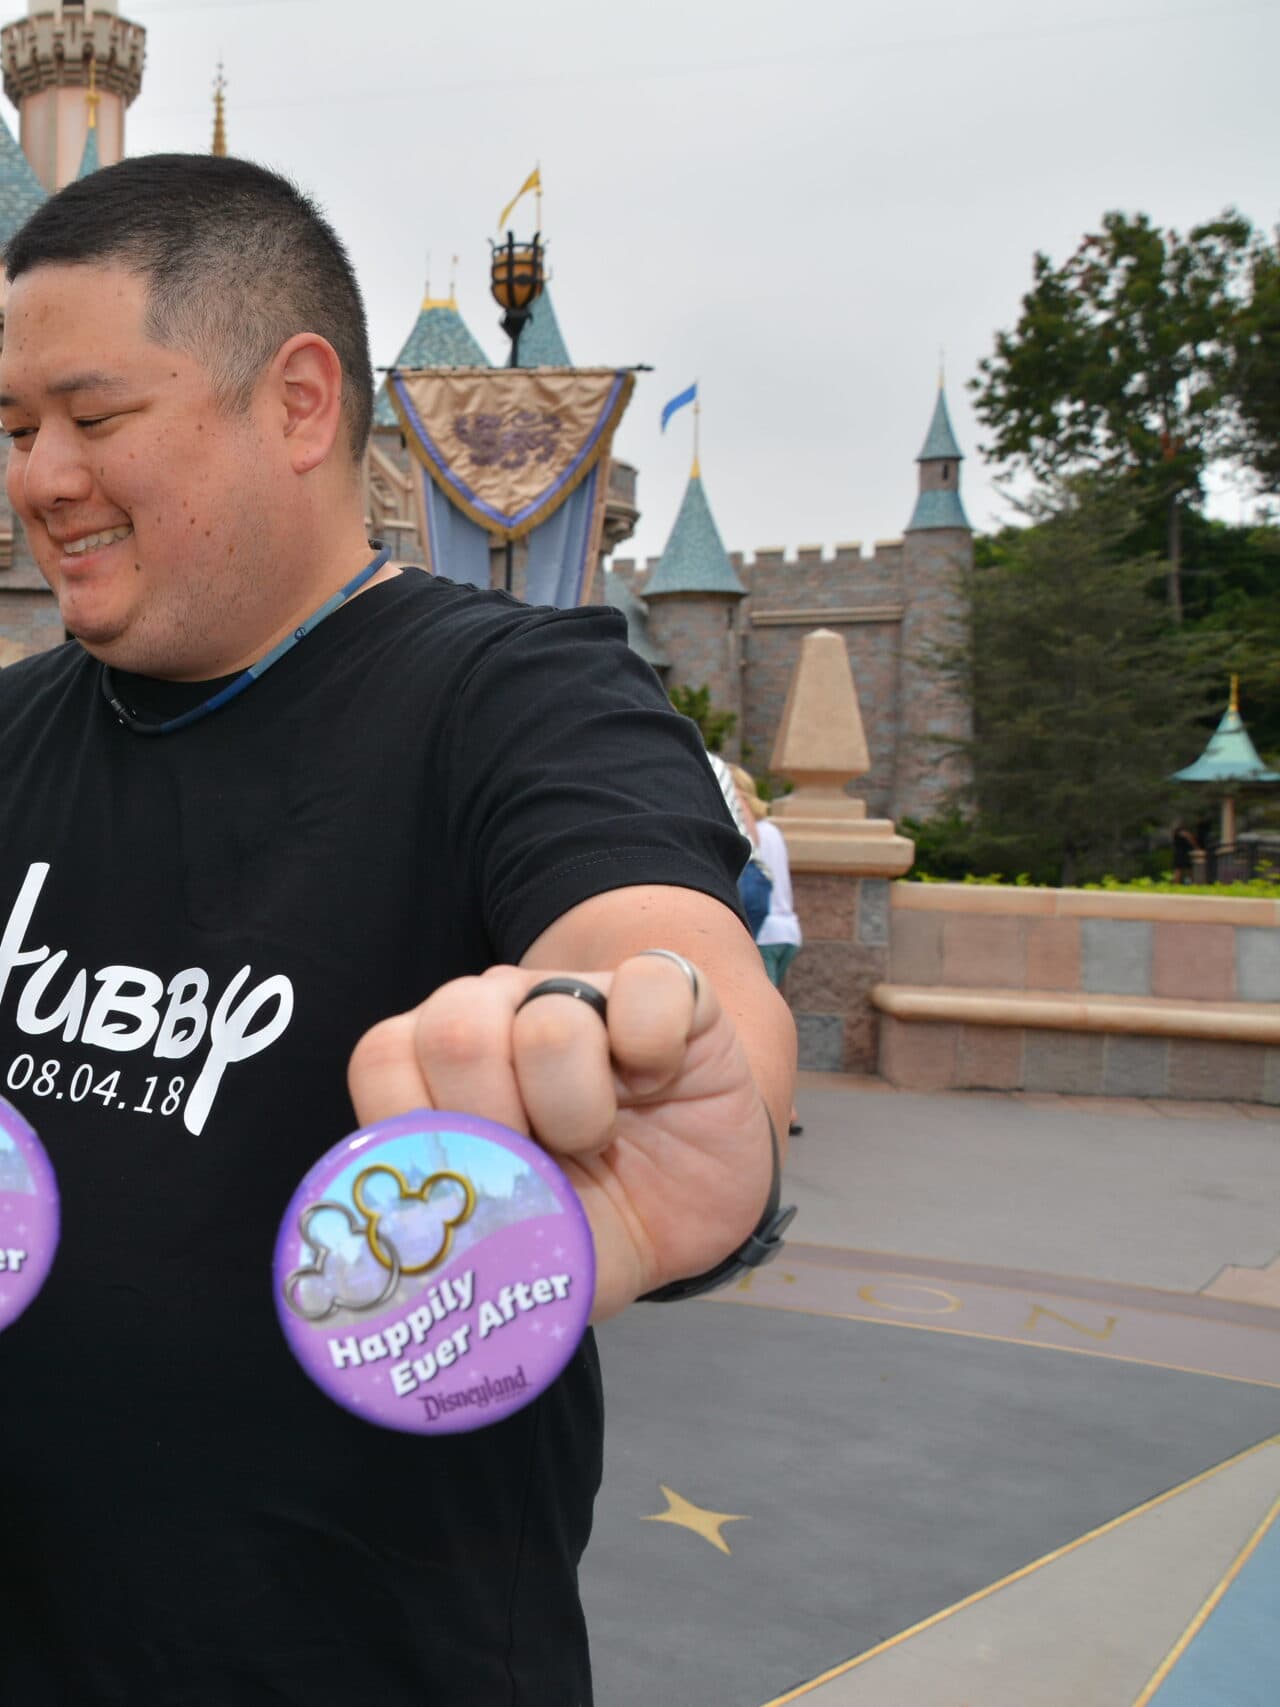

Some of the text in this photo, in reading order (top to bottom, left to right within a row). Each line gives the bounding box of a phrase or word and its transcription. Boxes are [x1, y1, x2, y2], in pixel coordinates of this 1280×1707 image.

[6, 1052, 186, 1117] 08.04.18
[327, 1269, 477, 1370] Happily
[389, 1272, 572, 1398] Ever After
[417, 1364, 531, 1422] Disneyland
